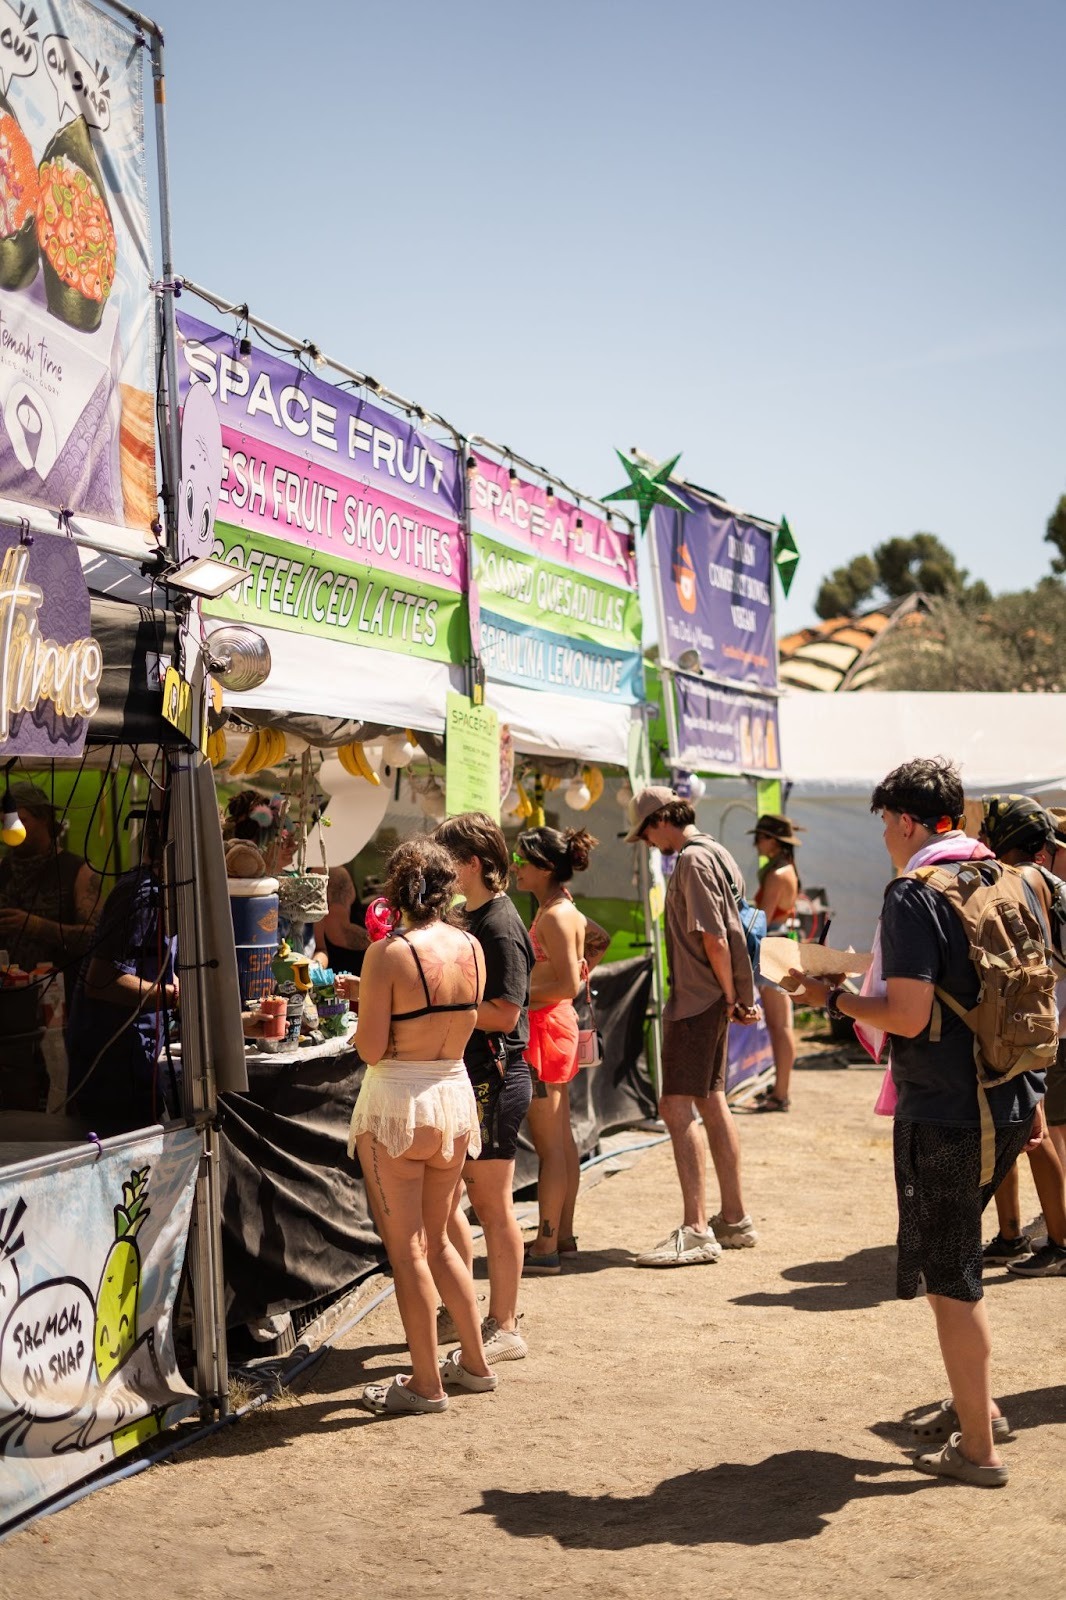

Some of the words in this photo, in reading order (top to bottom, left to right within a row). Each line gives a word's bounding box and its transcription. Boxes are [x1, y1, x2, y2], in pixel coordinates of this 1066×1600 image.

[183, 338, 338, 451] SPACE
[348, 414, 444, 494] FRUIT
[219, 444, 267, 516] ESH
[272, 465, 338, 538] FRUIT
[342, 494, 453, 577] SMOOTHIES
[358, 581, 439, 647] LATTES
[536, 569, 625, 632] QUESADILLAS
[479, 622, 546, 680] SPIRULINA
[548, 644, 624, 694] LEMONADE
[13, 1301, 83, 1360] SALMON,
[49, 1339, 84, 1384] SNAP
